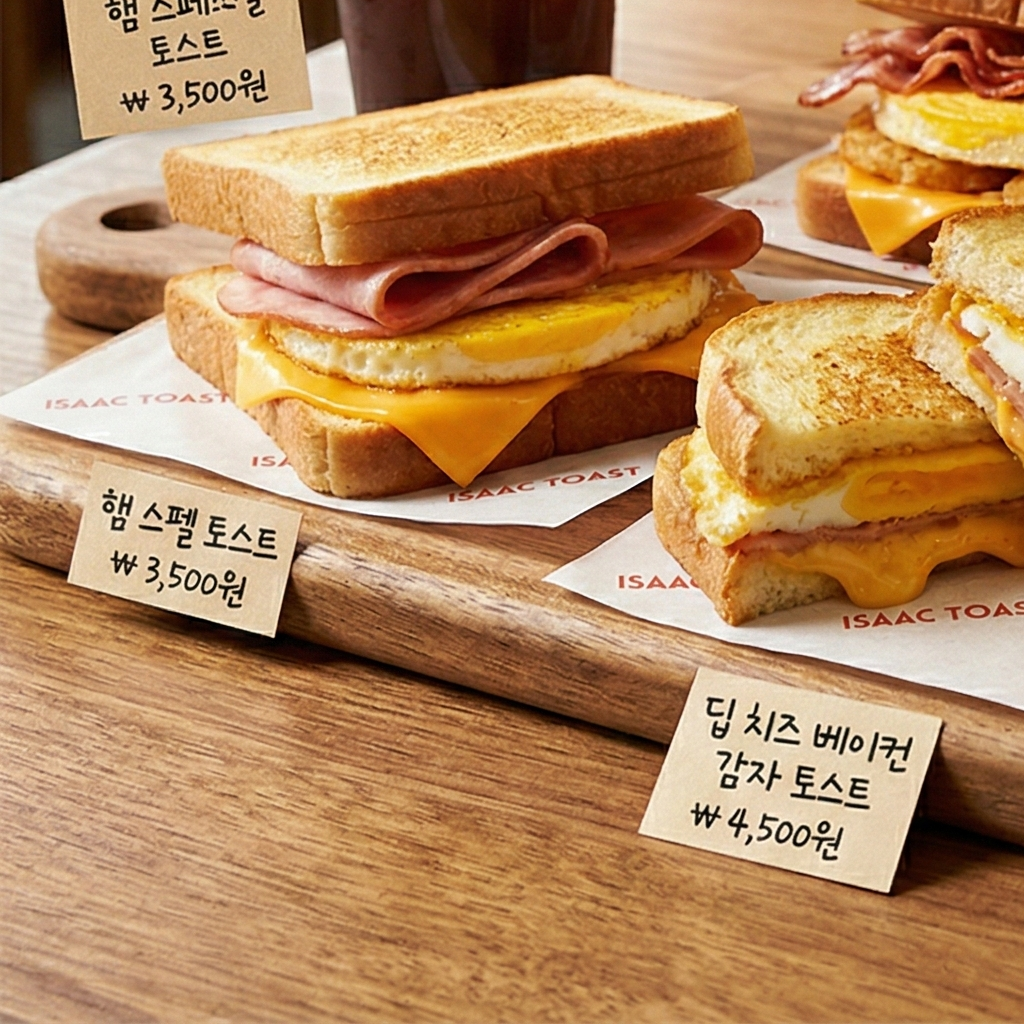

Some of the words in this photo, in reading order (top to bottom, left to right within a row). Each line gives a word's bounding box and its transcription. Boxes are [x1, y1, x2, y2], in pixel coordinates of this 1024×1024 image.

[150, 28, 229, 68] 토스트
[157, 68, 270, 115] 3,500원
[44, 395, 129, 410] ISAAC
[138, 392, 229, 405] TOAST
[448, 481, 535, 503] ISAAC
[543, 466, 641, 487] TOAST
[102, 488, 134, 532] 햄
[138, 502, 199, 550] 스펠
[203, 515, 278, 560] 토스트
[144, 556, 247, 609] 3,500원
[842, 607, 937, 630] ISAAC
[706, 696, 736, 740] 딥
[743, 702, 801, 746] 치즈
[812, 723, 914, 774] 베이컨
[716, 750, 782, 792] 감자
[790, 764, 871, 810] 토스트
[727, 808, 844, 861] 4,500원
